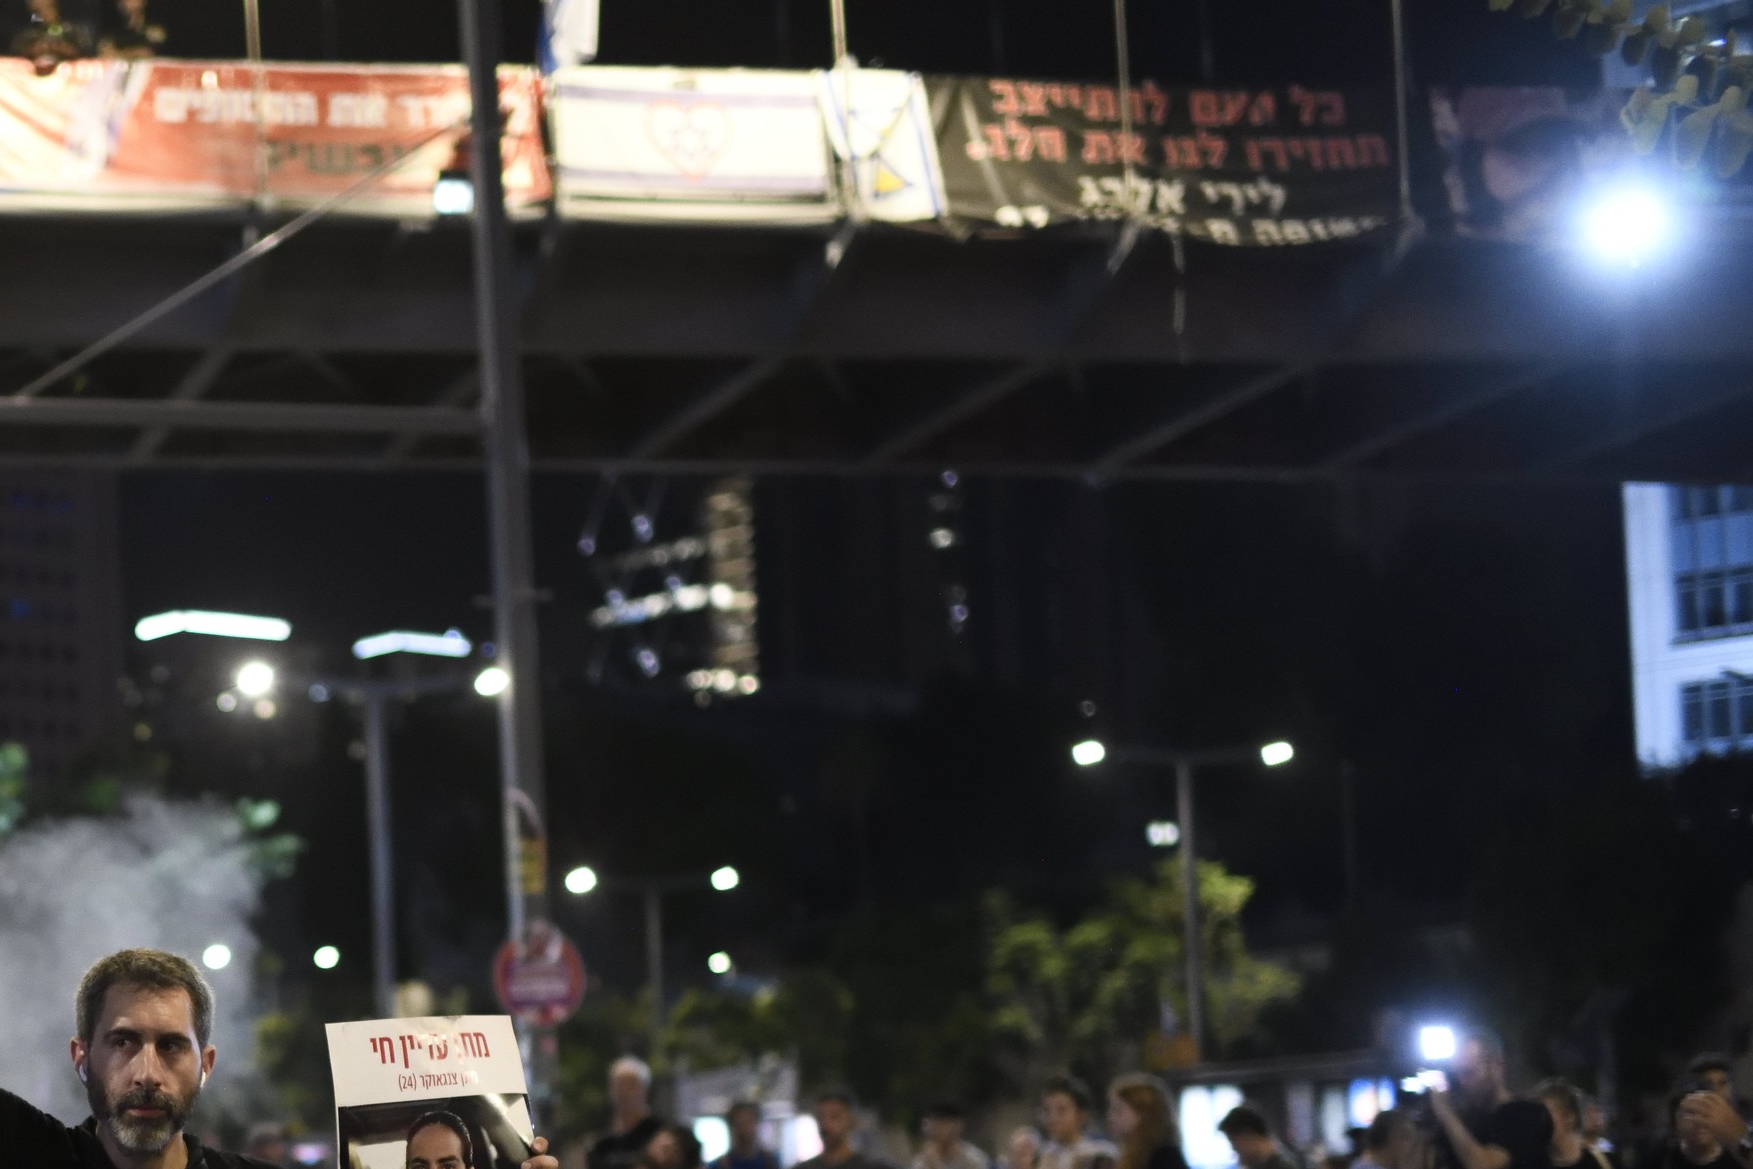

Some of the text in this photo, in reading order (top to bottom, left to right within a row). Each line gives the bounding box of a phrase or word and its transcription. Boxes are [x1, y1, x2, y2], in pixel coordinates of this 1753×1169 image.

[369, 1036, 396, 1064] חי
[399, 1034, 449, 1069] עדיין
[398, 1073, 417, 1092] (24)
